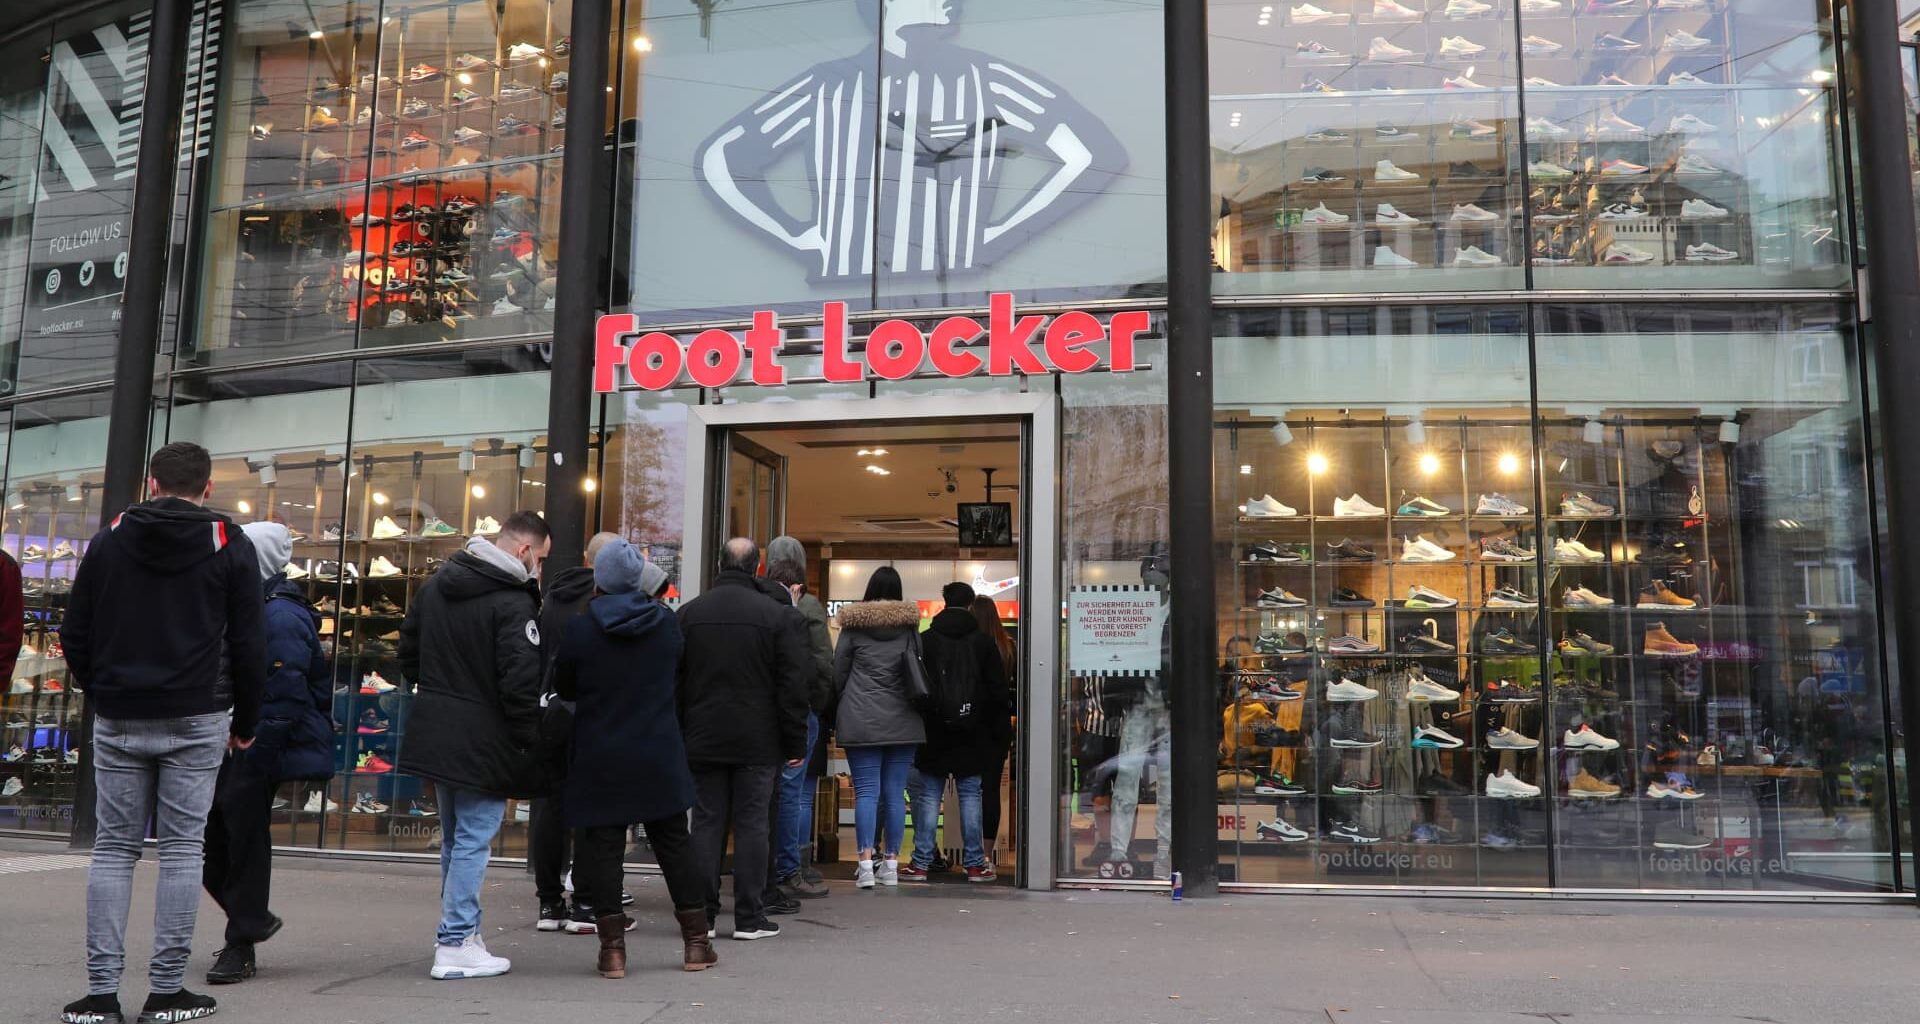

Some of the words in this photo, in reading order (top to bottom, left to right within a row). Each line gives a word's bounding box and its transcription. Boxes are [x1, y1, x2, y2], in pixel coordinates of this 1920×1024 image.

[49, 227, 102, 255] FOLLOW
[103, 221, 121, 241] US
[40, 319, 84, 335] footlocker.eu
[593, 310, 788, 394] foot
[821, 291, 1151, 383] Locker
[1311, 848, 1453, 869] footlocker.eu
[1649, 852, 1795, 874] footlocker.eu
